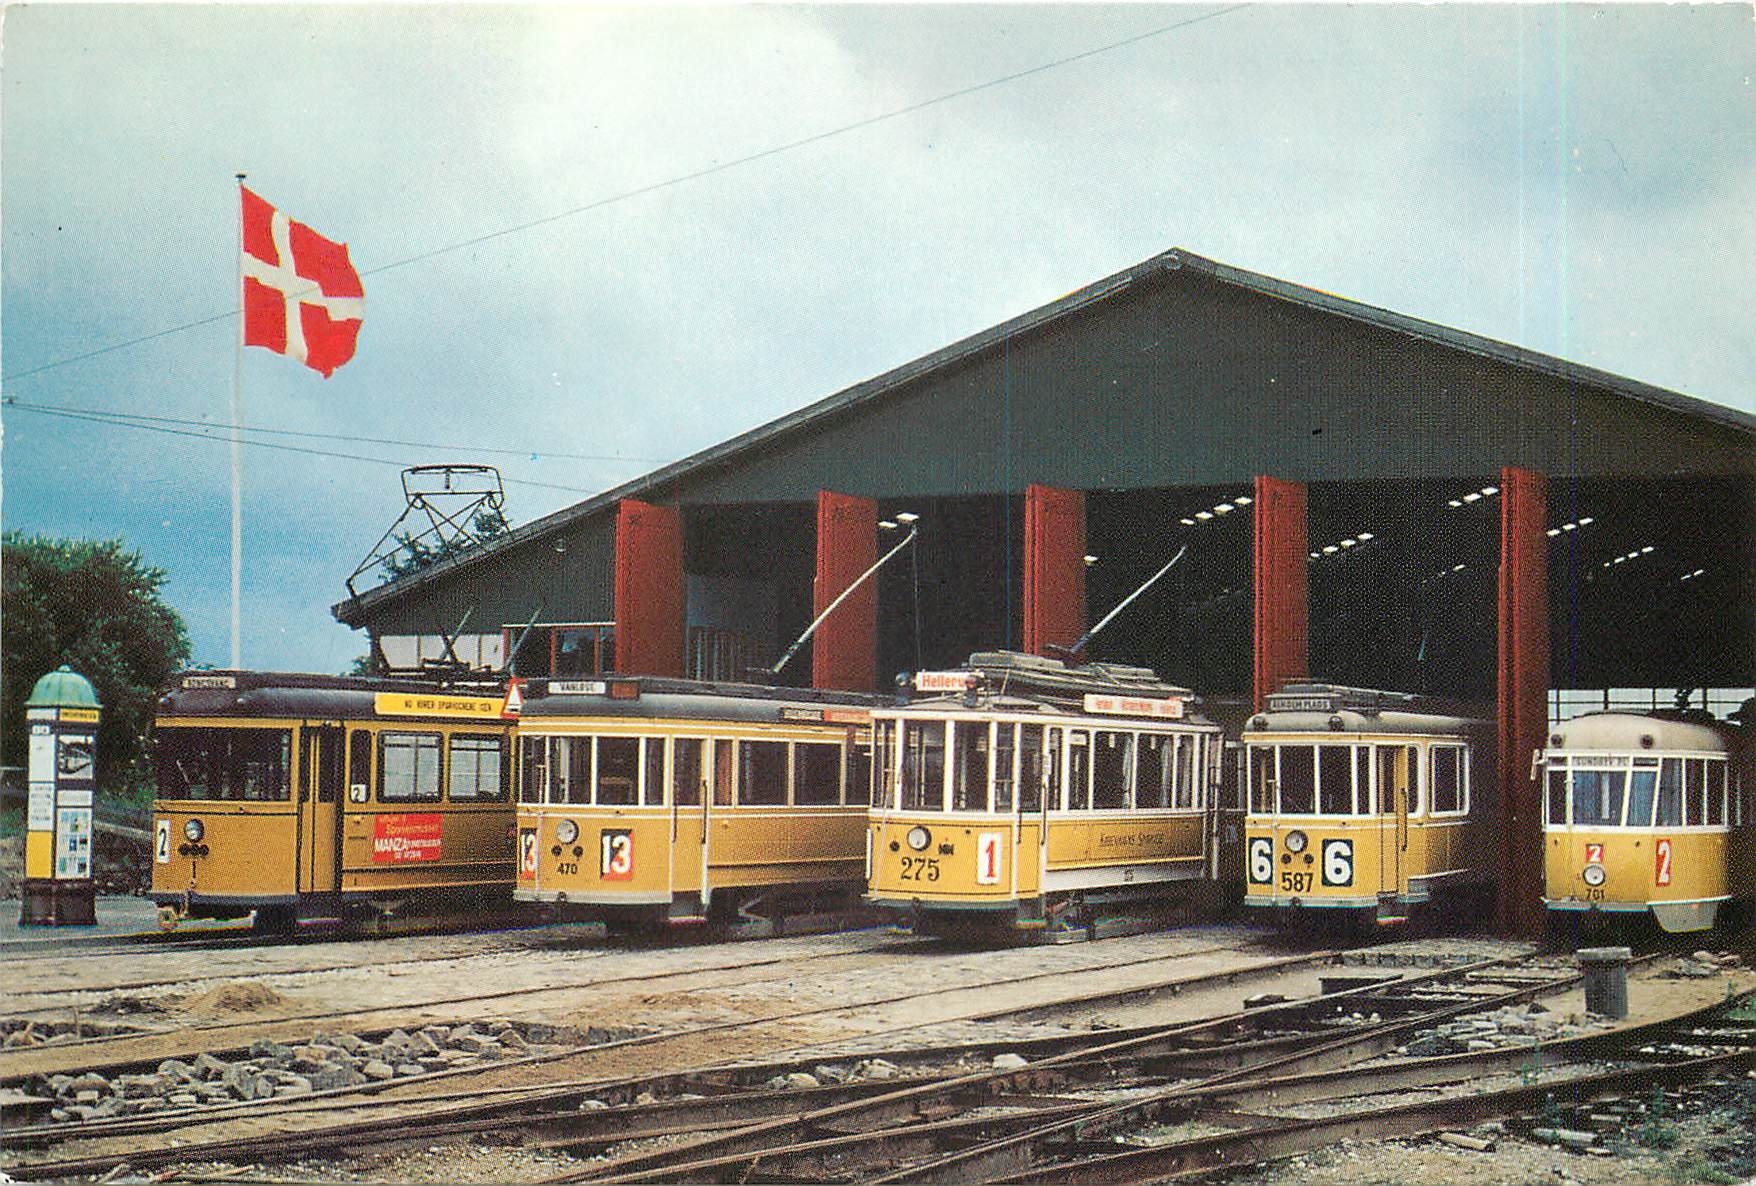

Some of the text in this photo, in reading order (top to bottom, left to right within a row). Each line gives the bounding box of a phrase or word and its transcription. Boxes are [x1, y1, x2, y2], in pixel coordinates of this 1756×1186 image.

[922, 674, 966, 688] Helleru
[158, 828, 168, 857] 2
[520, 834, 538, 873] 13
[602, 834, 632, 875] 13
[1588, 845, 1601, 862] 2
[557, 862, 578, 875] 470
[900, 857, 940, 882] 275
[985, 840, 996, 878] 1
[1250, 839, 1272, 881] 6
[1324, 841, 1352, 884] 6
[1658, 841, 1671, 883] 2
[1281, 872, 1314, 893] 587
[1586, 889, 1605, 900] 701
